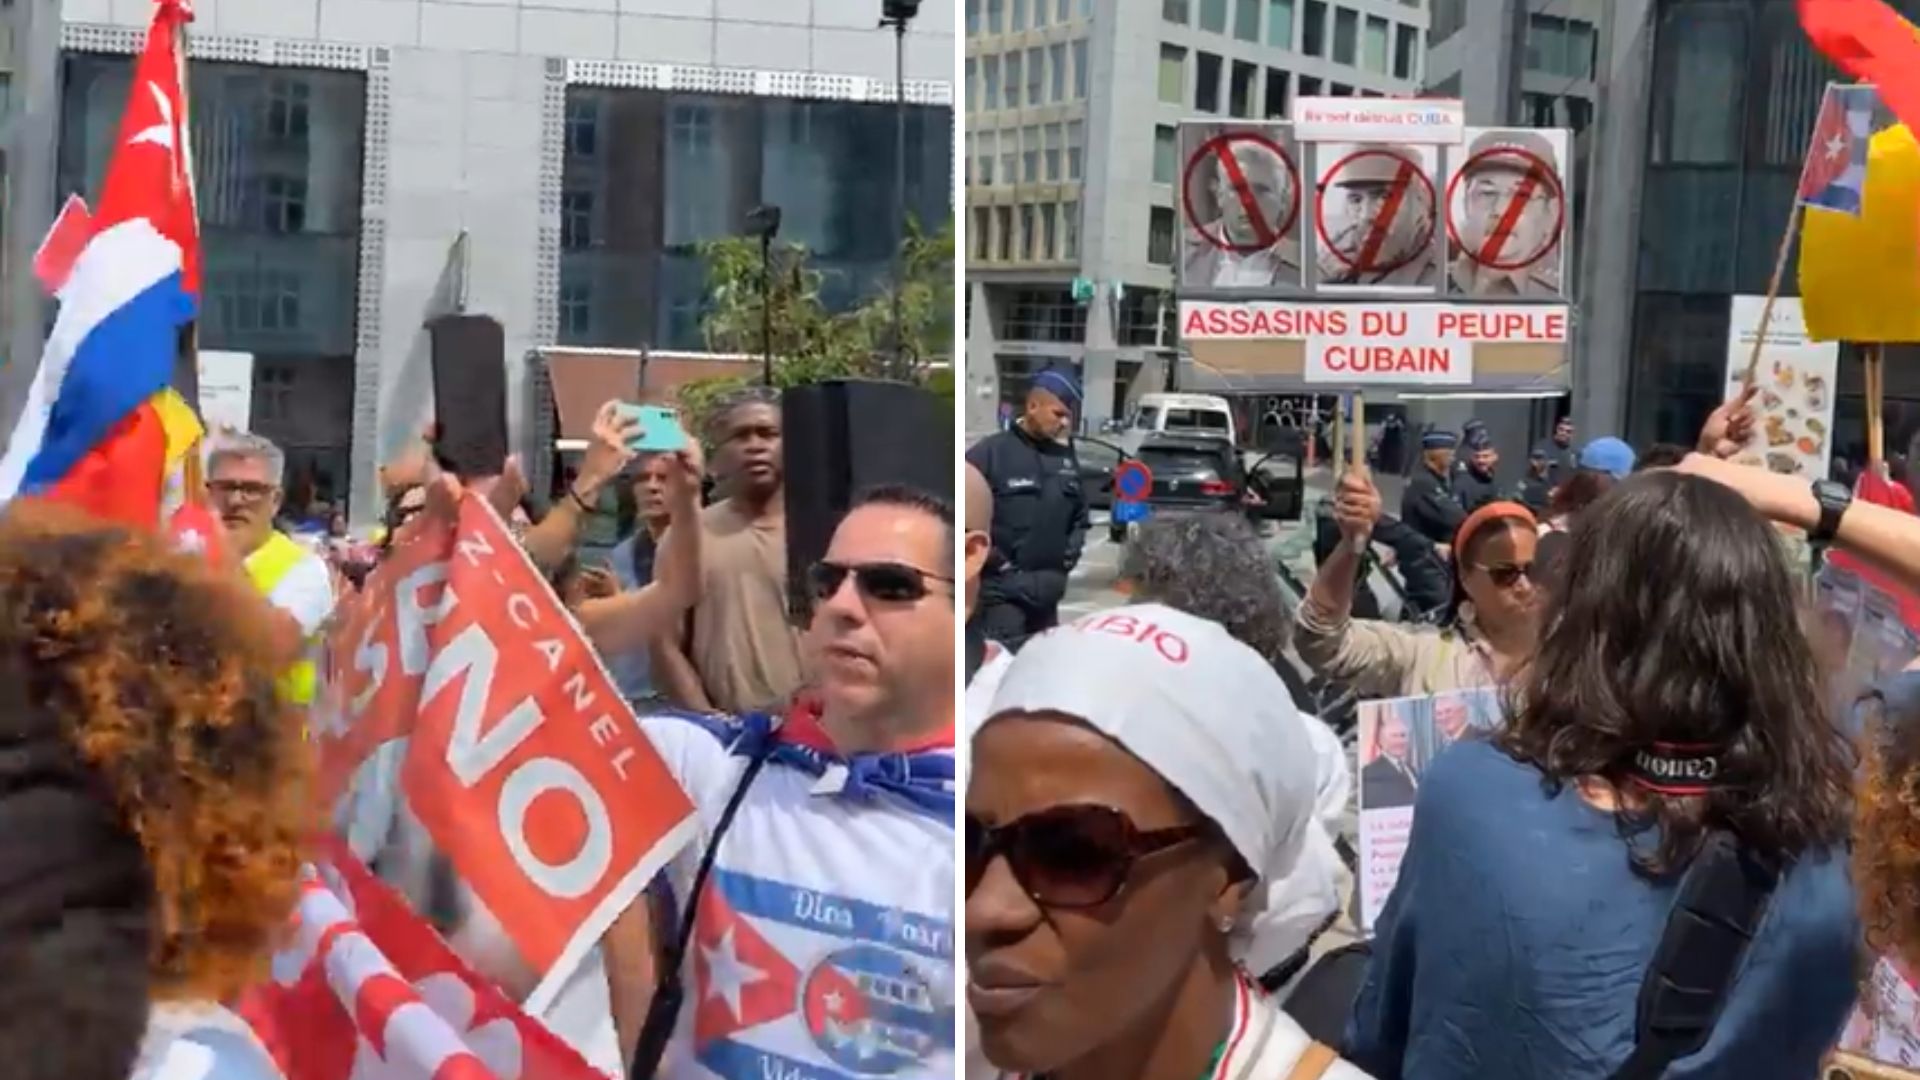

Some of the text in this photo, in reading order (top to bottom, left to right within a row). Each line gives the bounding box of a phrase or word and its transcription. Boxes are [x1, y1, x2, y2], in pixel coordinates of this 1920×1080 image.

[1184, 309, 1564, 340] ASSASINS DU PEUPLE
[1324, 345, 1450, 373] CUBAIN
[1635, 748, 1718, 780] Canon
